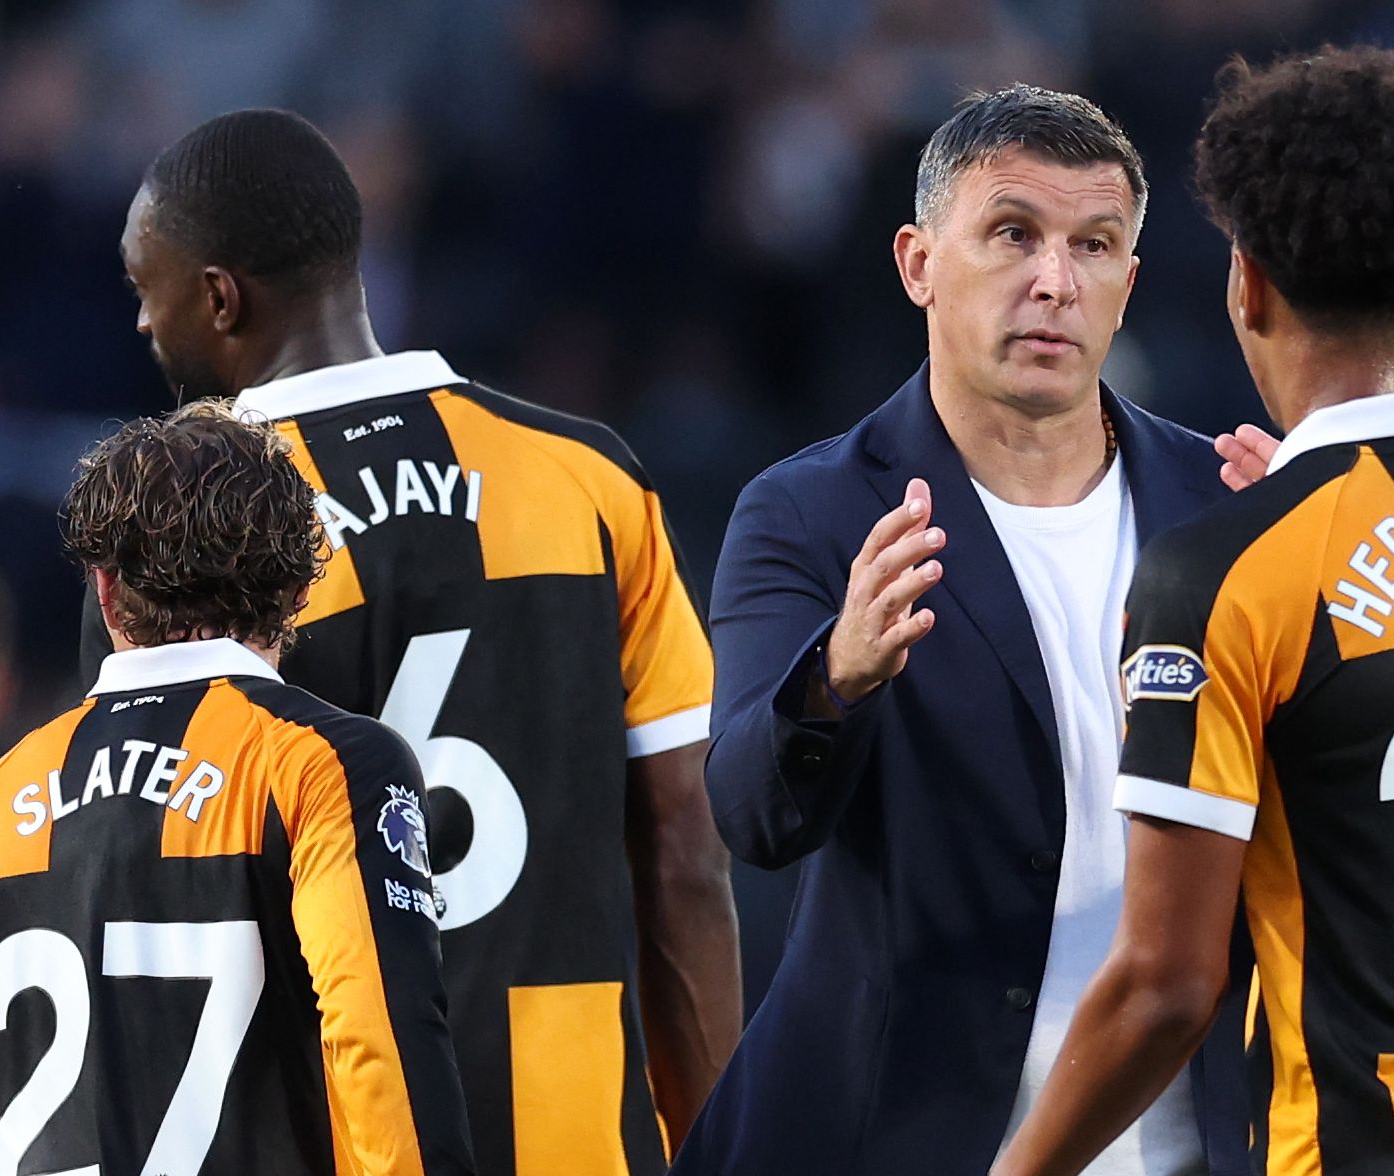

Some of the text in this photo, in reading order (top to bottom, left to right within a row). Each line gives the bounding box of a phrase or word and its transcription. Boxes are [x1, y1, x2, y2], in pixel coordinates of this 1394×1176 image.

[343, 414, 404, 442] Est. 1904
[313, 458, 482, 551] AJAYI
[11, 738, 225, 837] SLATER
[380, 628, 528, 931] 6
[384, 878, 411, 898] No
